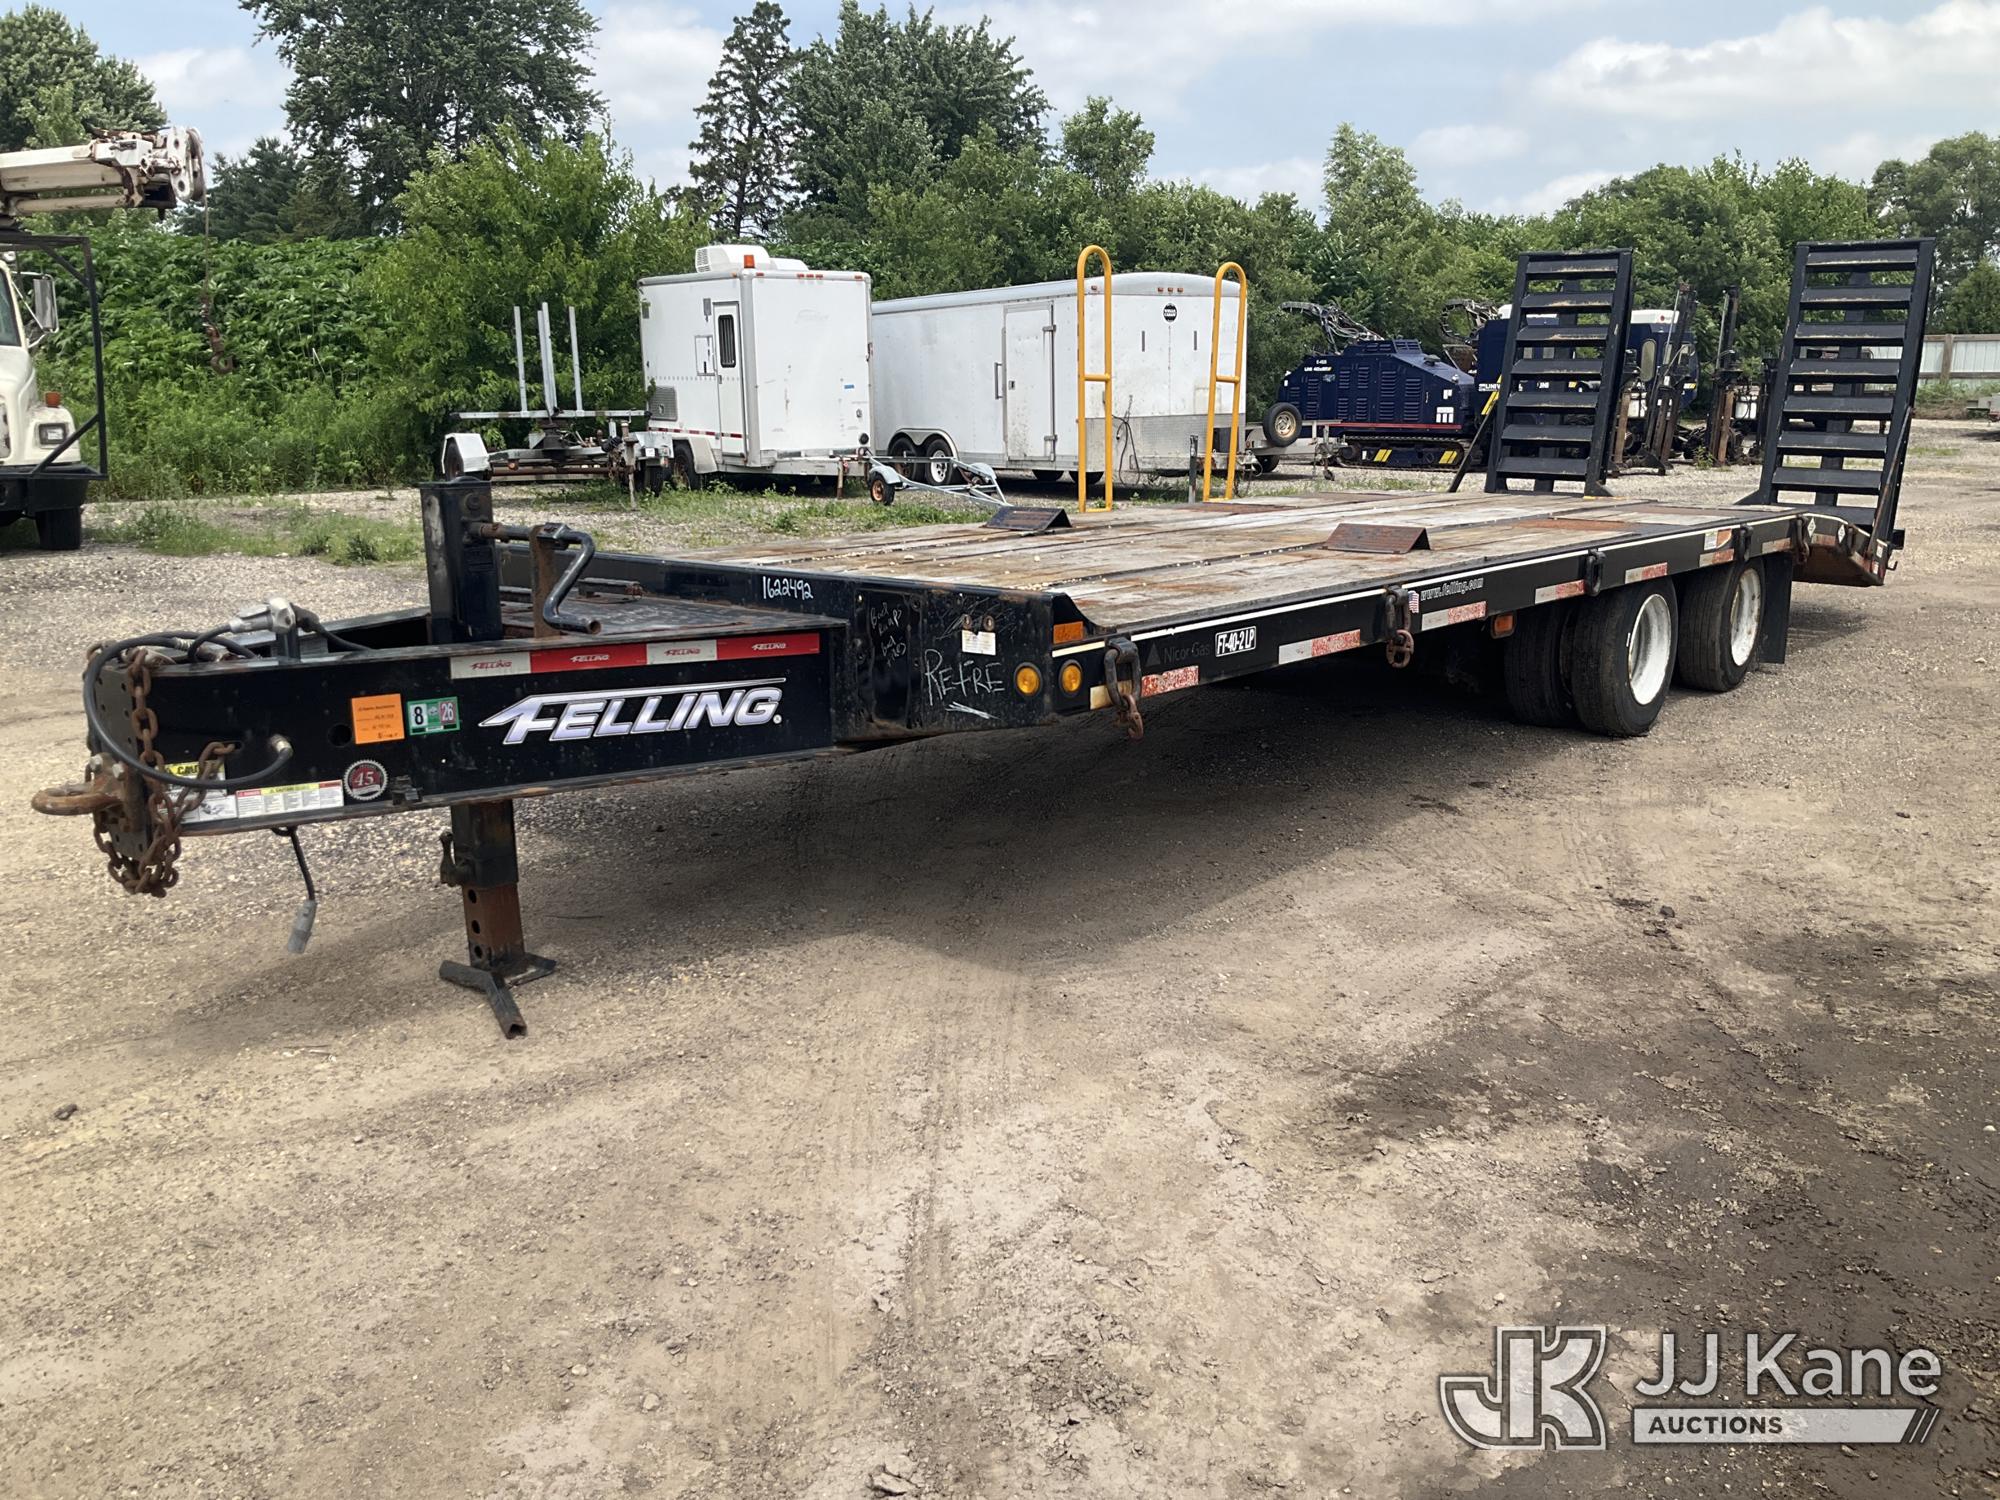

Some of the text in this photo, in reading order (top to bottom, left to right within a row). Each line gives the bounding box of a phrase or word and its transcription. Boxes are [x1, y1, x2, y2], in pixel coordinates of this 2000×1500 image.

[762, 575, 814, 601] 1622492
[414, 705, 425, 726] 8
[441, 702, 455, 722] 26
[354, 771, 375, 787] 45
